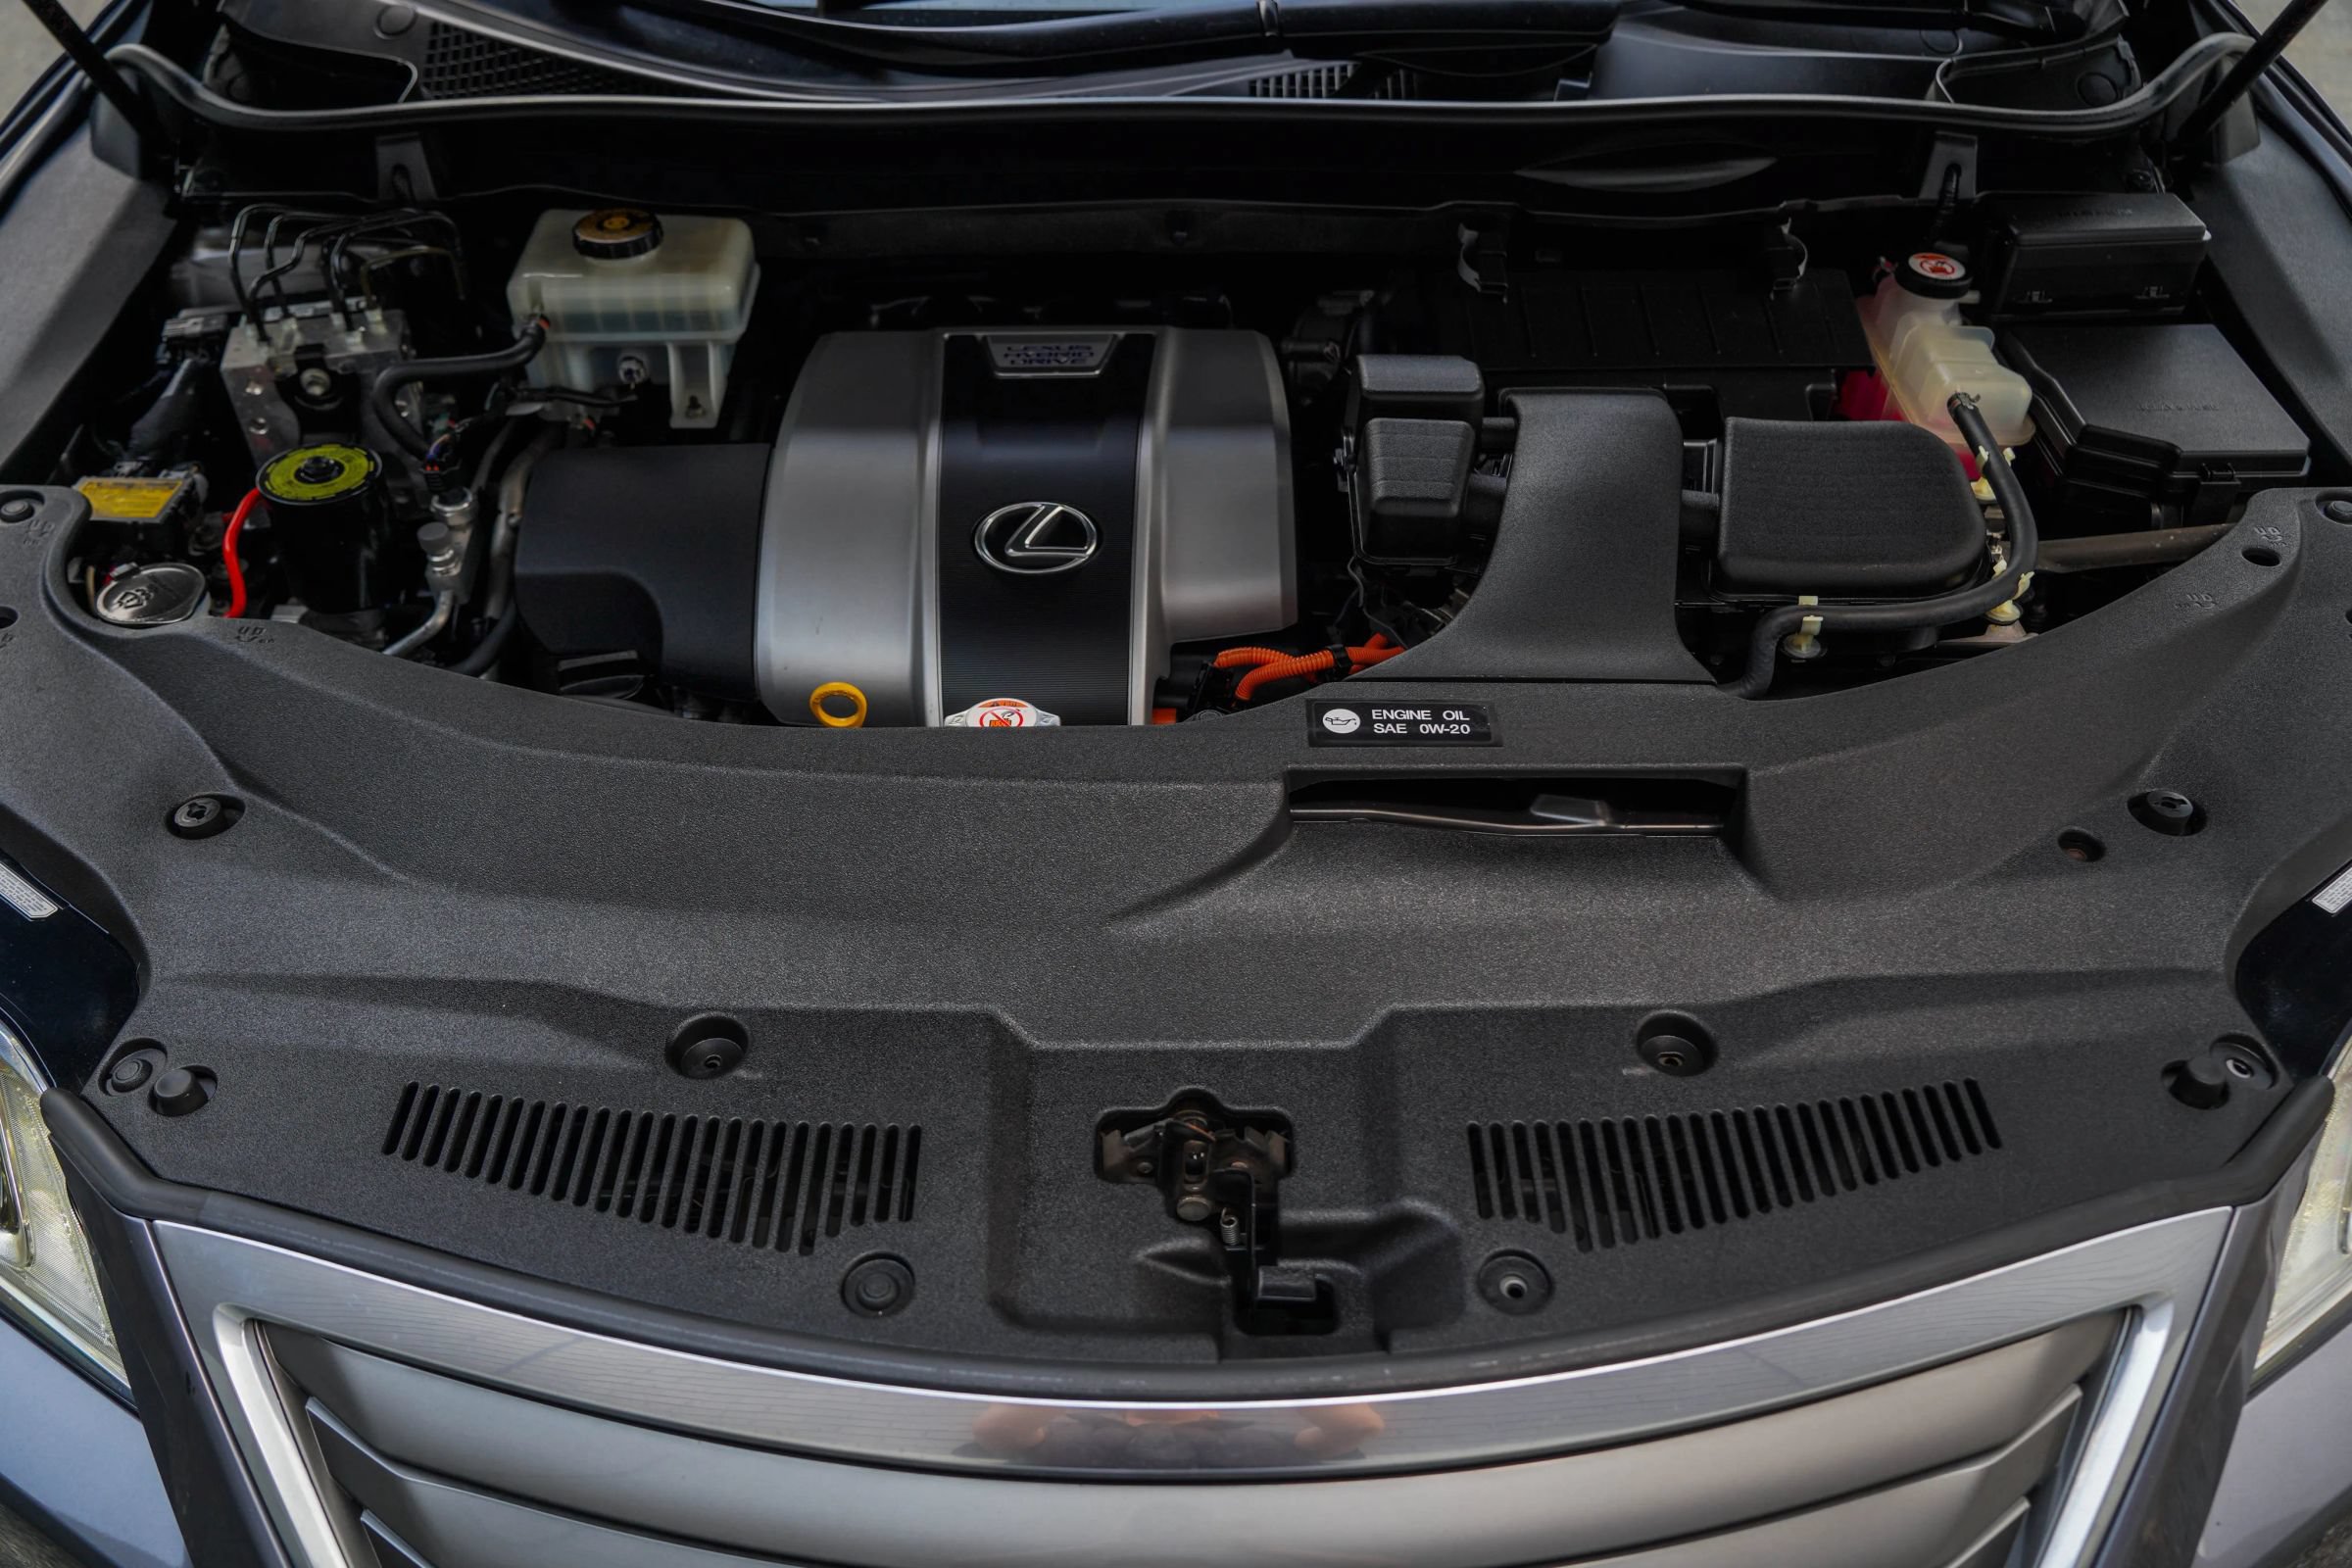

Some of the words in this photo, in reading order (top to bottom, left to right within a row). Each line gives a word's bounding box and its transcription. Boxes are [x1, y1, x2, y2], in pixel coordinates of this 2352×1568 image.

[1371, 709, 1432, 720] ENGINE
[1443, 710, 1470, 721] OIL
[1373, 723, 1407, 734] SAE
[1419, 723, 1471, 735] 0W-20
